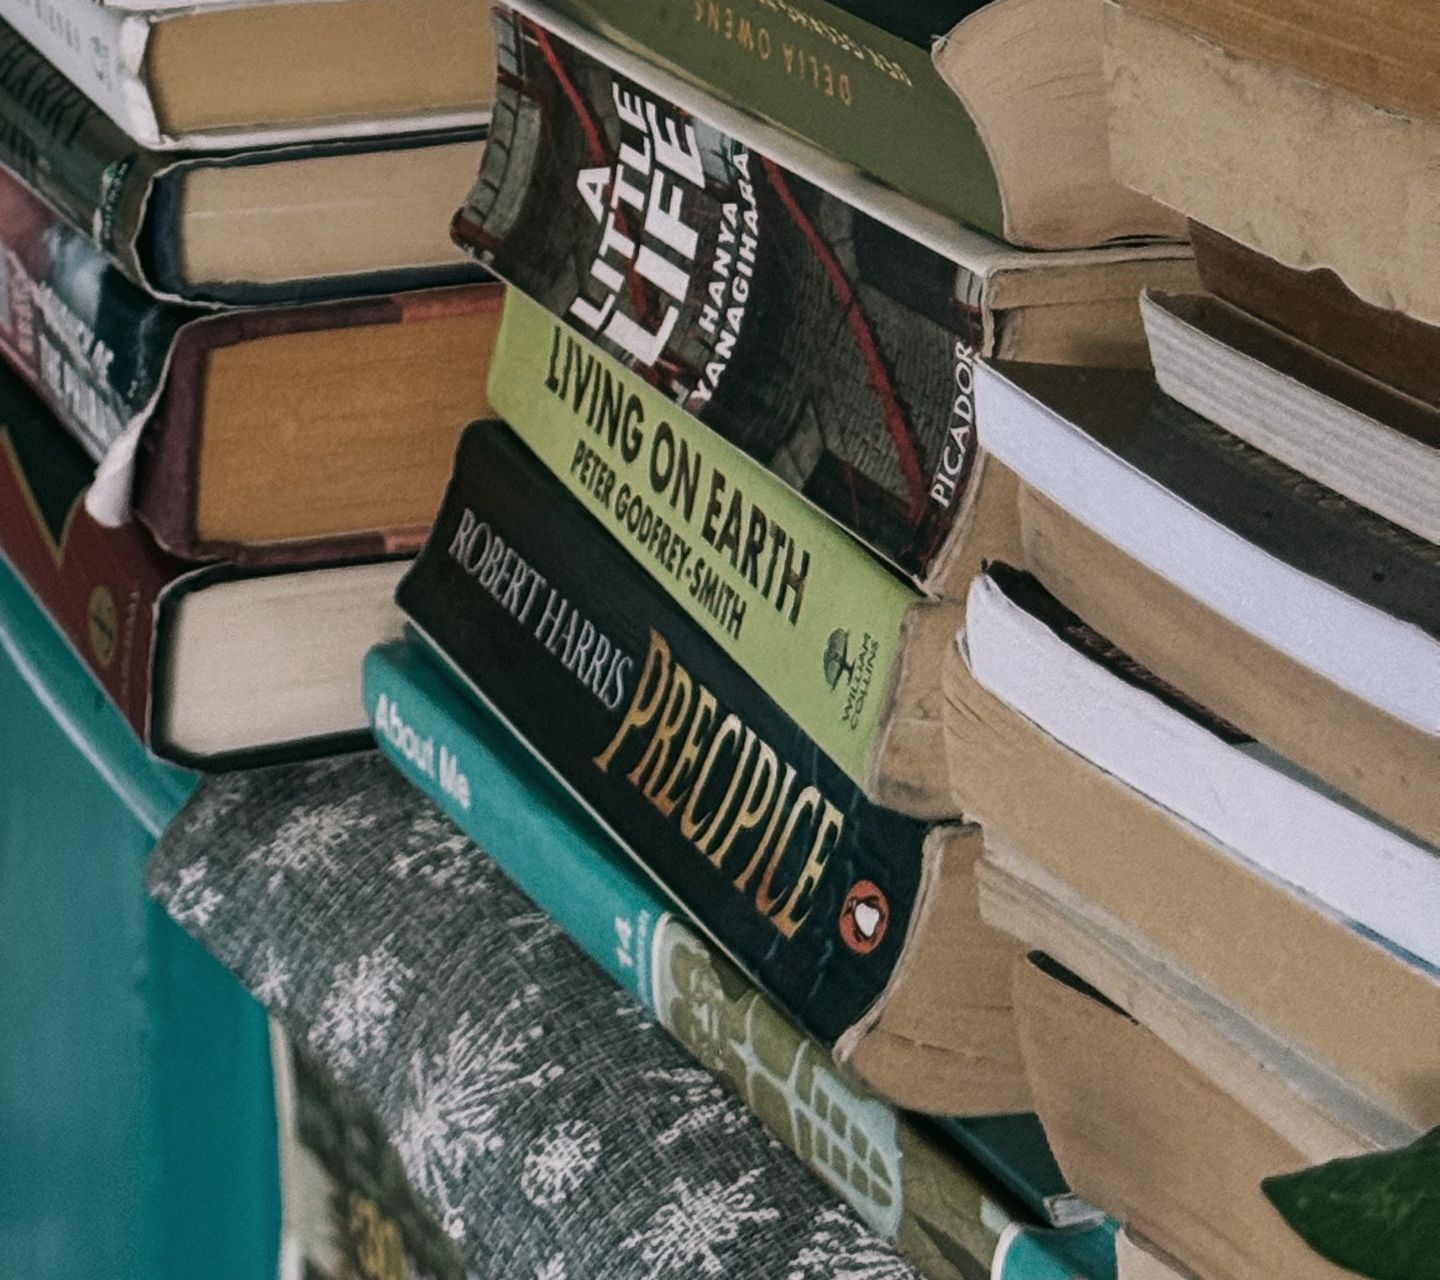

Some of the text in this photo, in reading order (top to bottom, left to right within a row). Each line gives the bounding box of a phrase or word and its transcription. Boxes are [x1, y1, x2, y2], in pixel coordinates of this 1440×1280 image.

[782, 43, 852, 106] DELIA
[569, 83, 651, 331] LITTLE
[577, 167, 611, 224] A
[603, 101, 705, 367] LIFE
[690, 153, 758, 401] YANAGIHARA
[699, 203, 738, 333] HANYA
[545, 325, 811, 627] LIVING ON EARTH
[931, 343, 975, 508] PICADOR
[570, 439, 748, 639] PETER GODFREY-SMITH
[376, 692, 471, 810] About Me
[450, 509, 846, 938] ROBERT HARRIS PRECIPICE
[842, 632, 871, 721] WILLIAM
[851, 641, 878, 730] COLLINS
